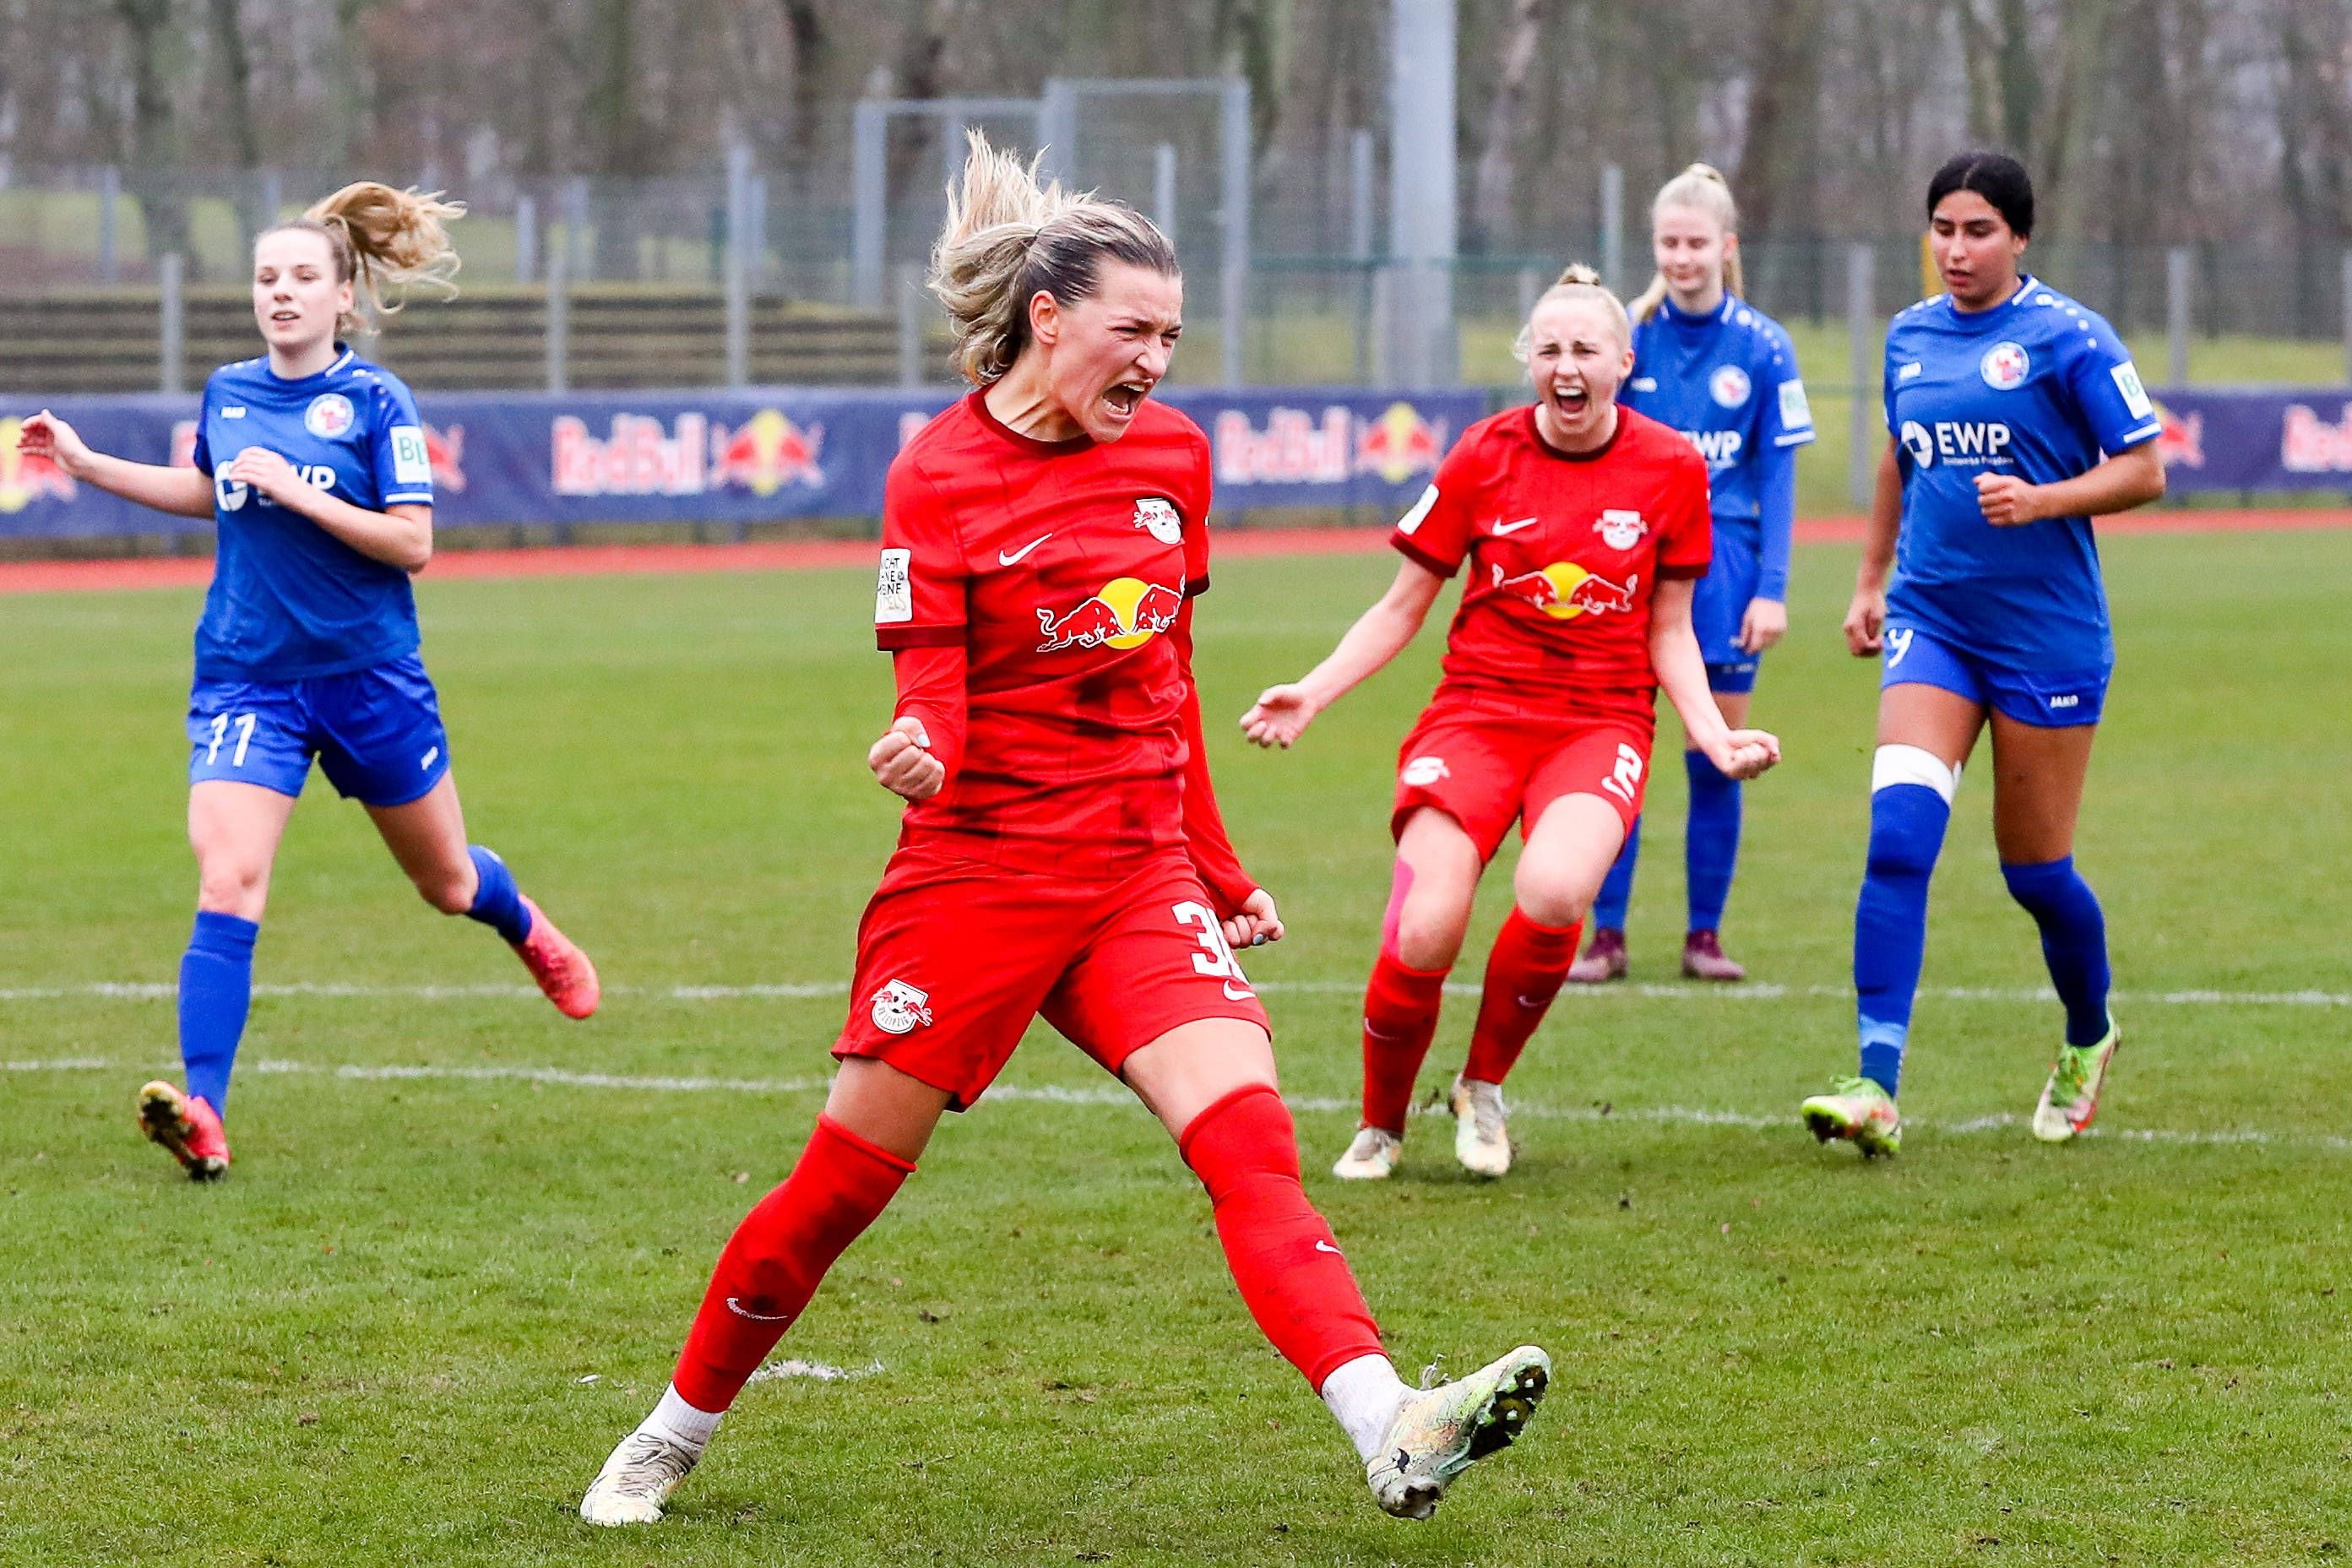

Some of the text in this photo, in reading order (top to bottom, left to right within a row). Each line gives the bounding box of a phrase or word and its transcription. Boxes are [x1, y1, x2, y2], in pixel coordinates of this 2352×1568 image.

[1679, 431, 1742, 461] WP
[1935, 421, 2011, 455] EWP
[206, 712, 257, 768] 11
[1613, 742, 1644, 799] 2
[1171, 900, 1250, 986] 3
